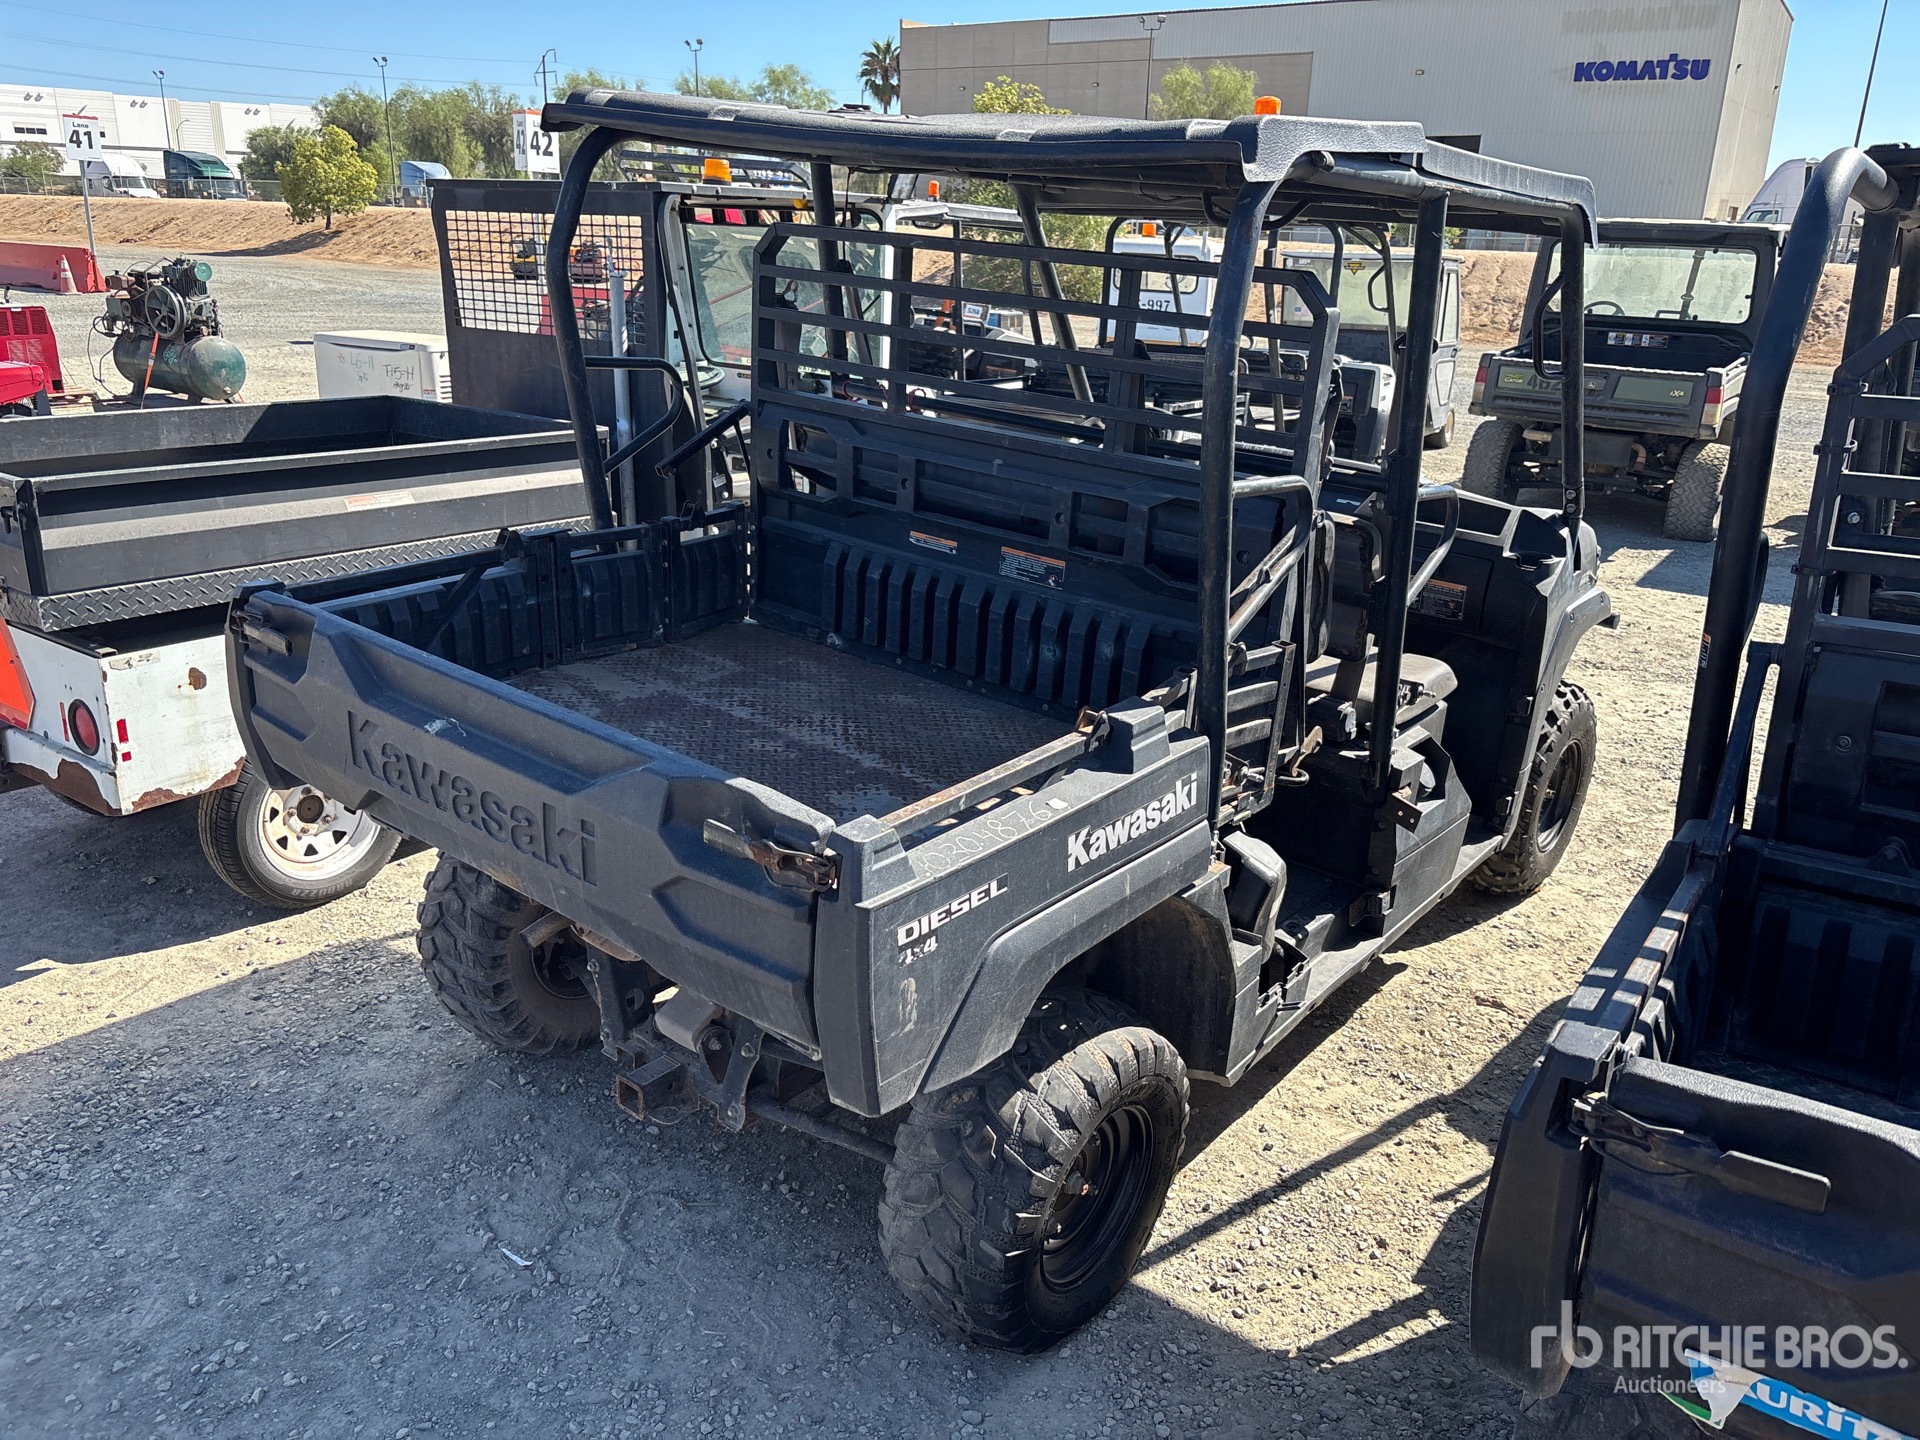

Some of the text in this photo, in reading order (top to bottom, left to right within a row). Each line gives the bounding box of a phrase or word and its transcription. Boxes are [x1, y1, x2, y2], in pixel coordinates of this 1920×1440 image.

[1573, 53, 1711, 82] KOMATSU
[69, 129, 94, 149] 41
[72, 121, 89, 129] Lane
[515, 129, 526, 155] 42
[530, 130, 554, 157] 42
[347, 709, 598, 887] Kawasaki
[1067, 771, 1198, 873] Kawasaki
[897, 877, 1008, 947] DIESEL
